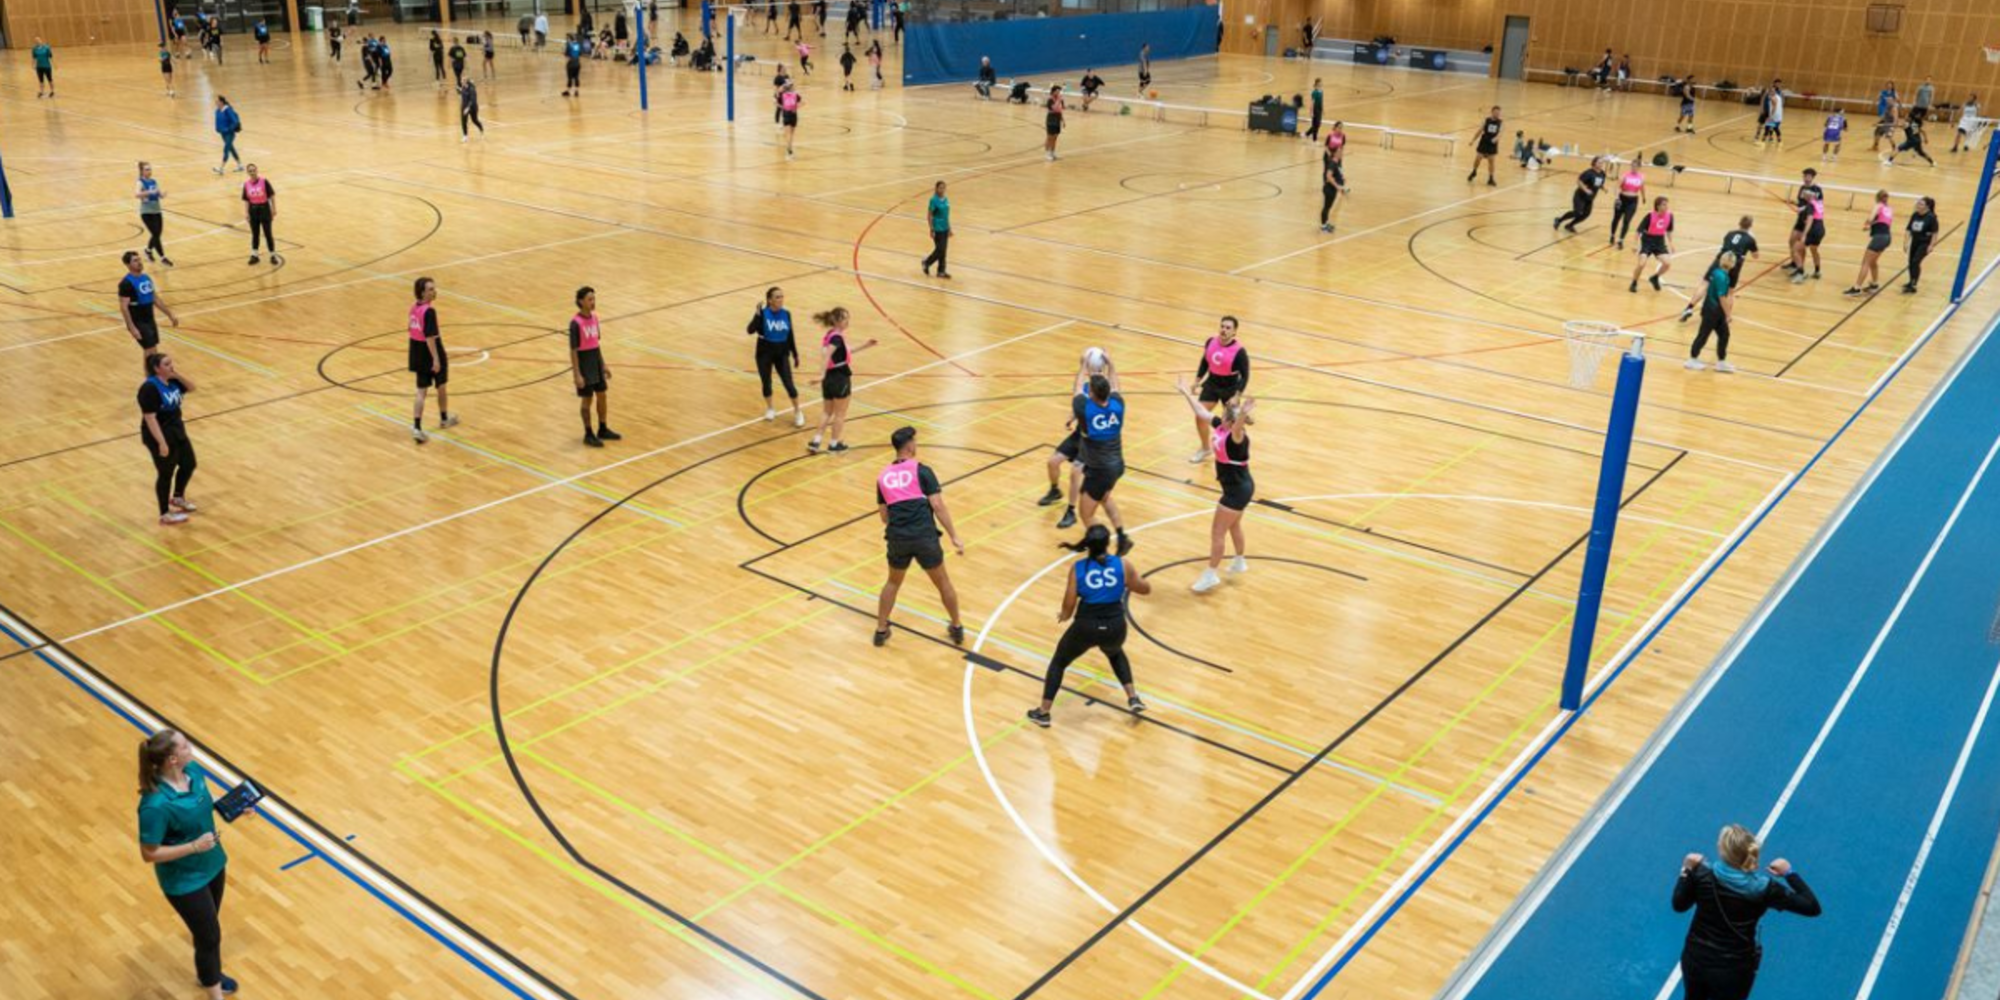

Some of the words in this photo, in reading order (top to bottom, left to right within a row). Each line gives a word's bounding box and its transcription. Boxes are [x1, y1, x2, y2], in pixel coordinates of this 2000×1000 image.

[767, 319, 789, 332] WA
[1212, 352, 1224, 365] C
[1092, 412, 1120, 430] GA
[883, 470, 912, 489] GD
[1085, 567, 1118, 589] GS
